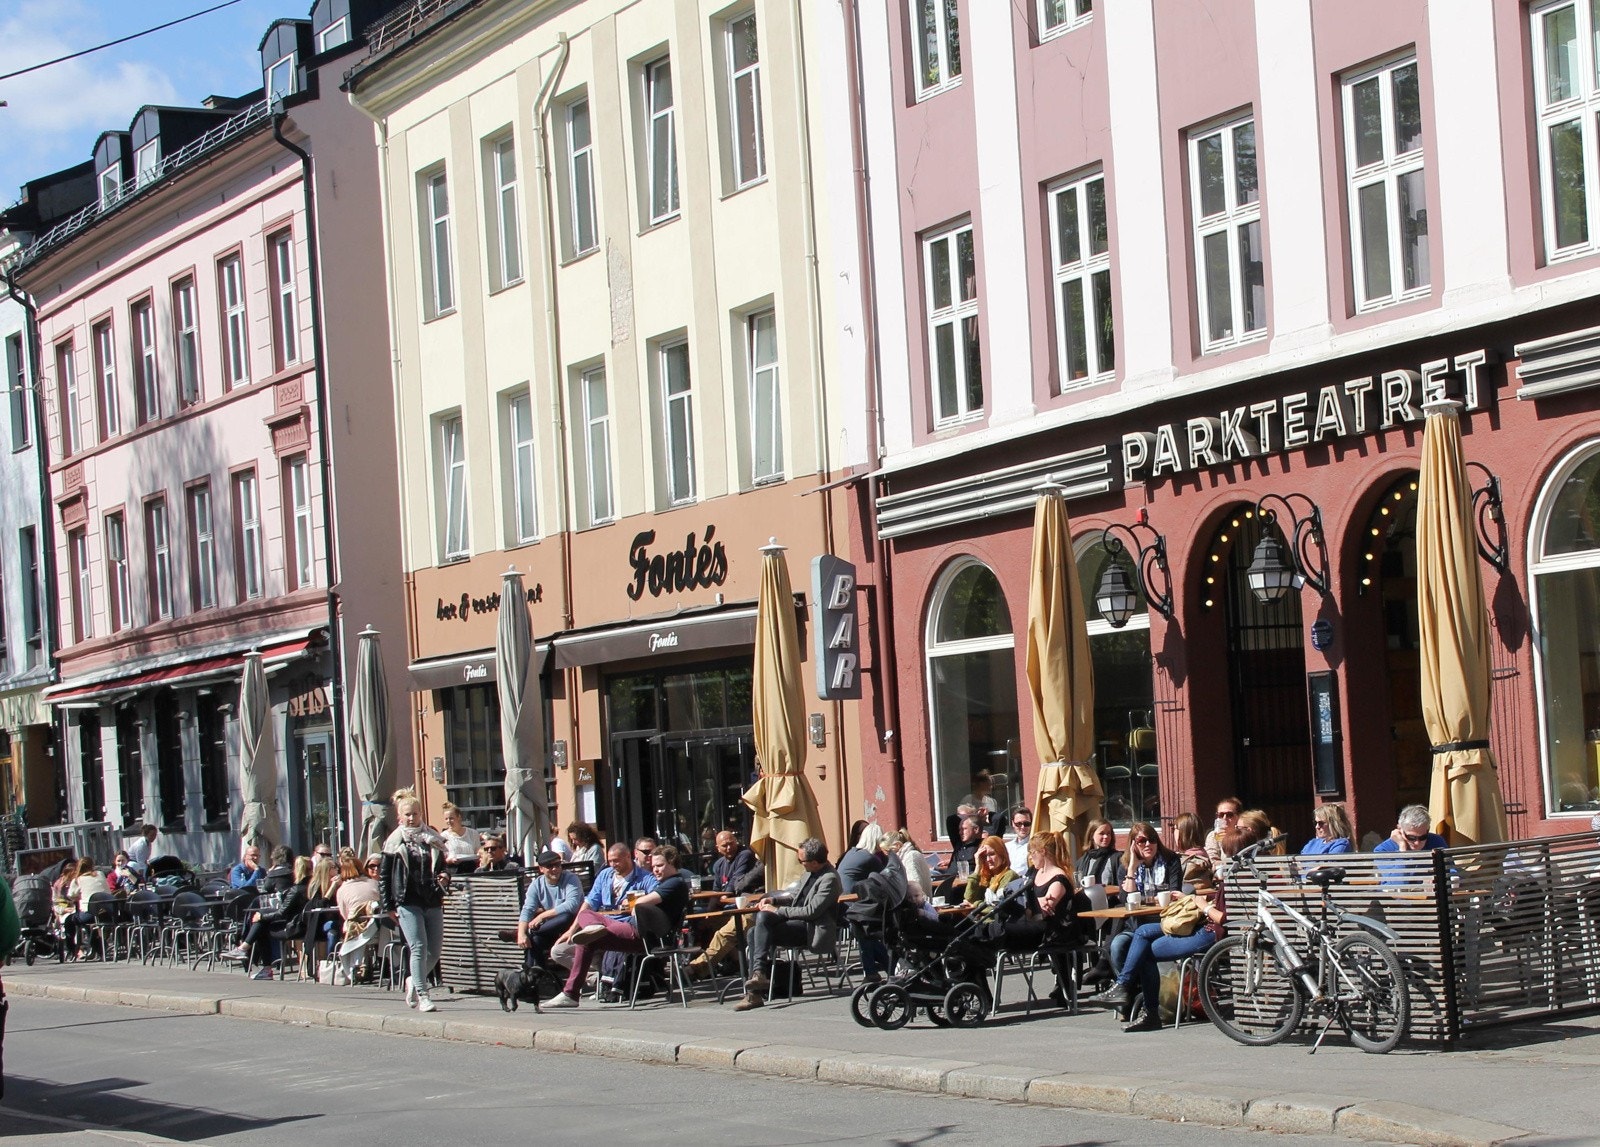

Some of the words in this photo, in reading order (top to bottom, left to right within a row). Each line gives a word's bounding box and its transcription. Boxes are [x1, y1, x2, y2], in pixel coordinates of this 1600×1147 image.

[1121, 348, 1487, 482] PARKTEATRET
[626, 524, 729, 602] Fontés
[827, 574, 858, 690] BAR
